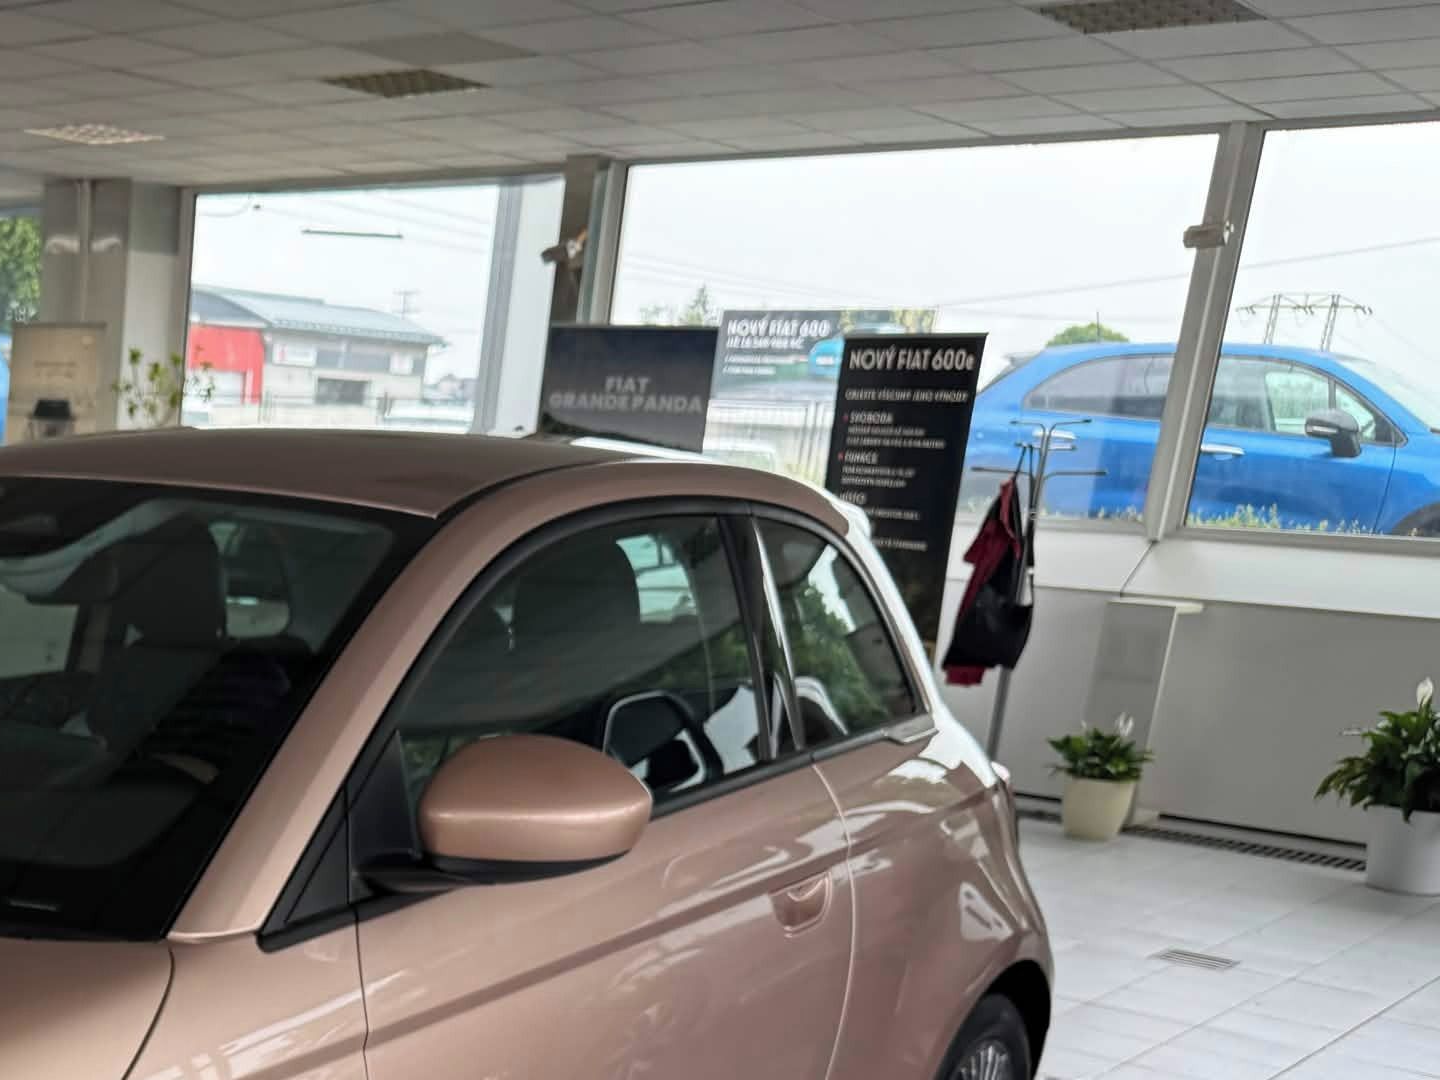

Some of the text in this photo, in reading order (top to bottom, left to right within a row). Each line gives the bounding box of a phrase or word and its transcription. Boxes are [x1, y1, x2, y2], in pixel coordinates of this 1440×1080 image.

[849, 344, 975, 371] NOVÝ FIAT 600e
[604, 375, 652, 393] FIAT
